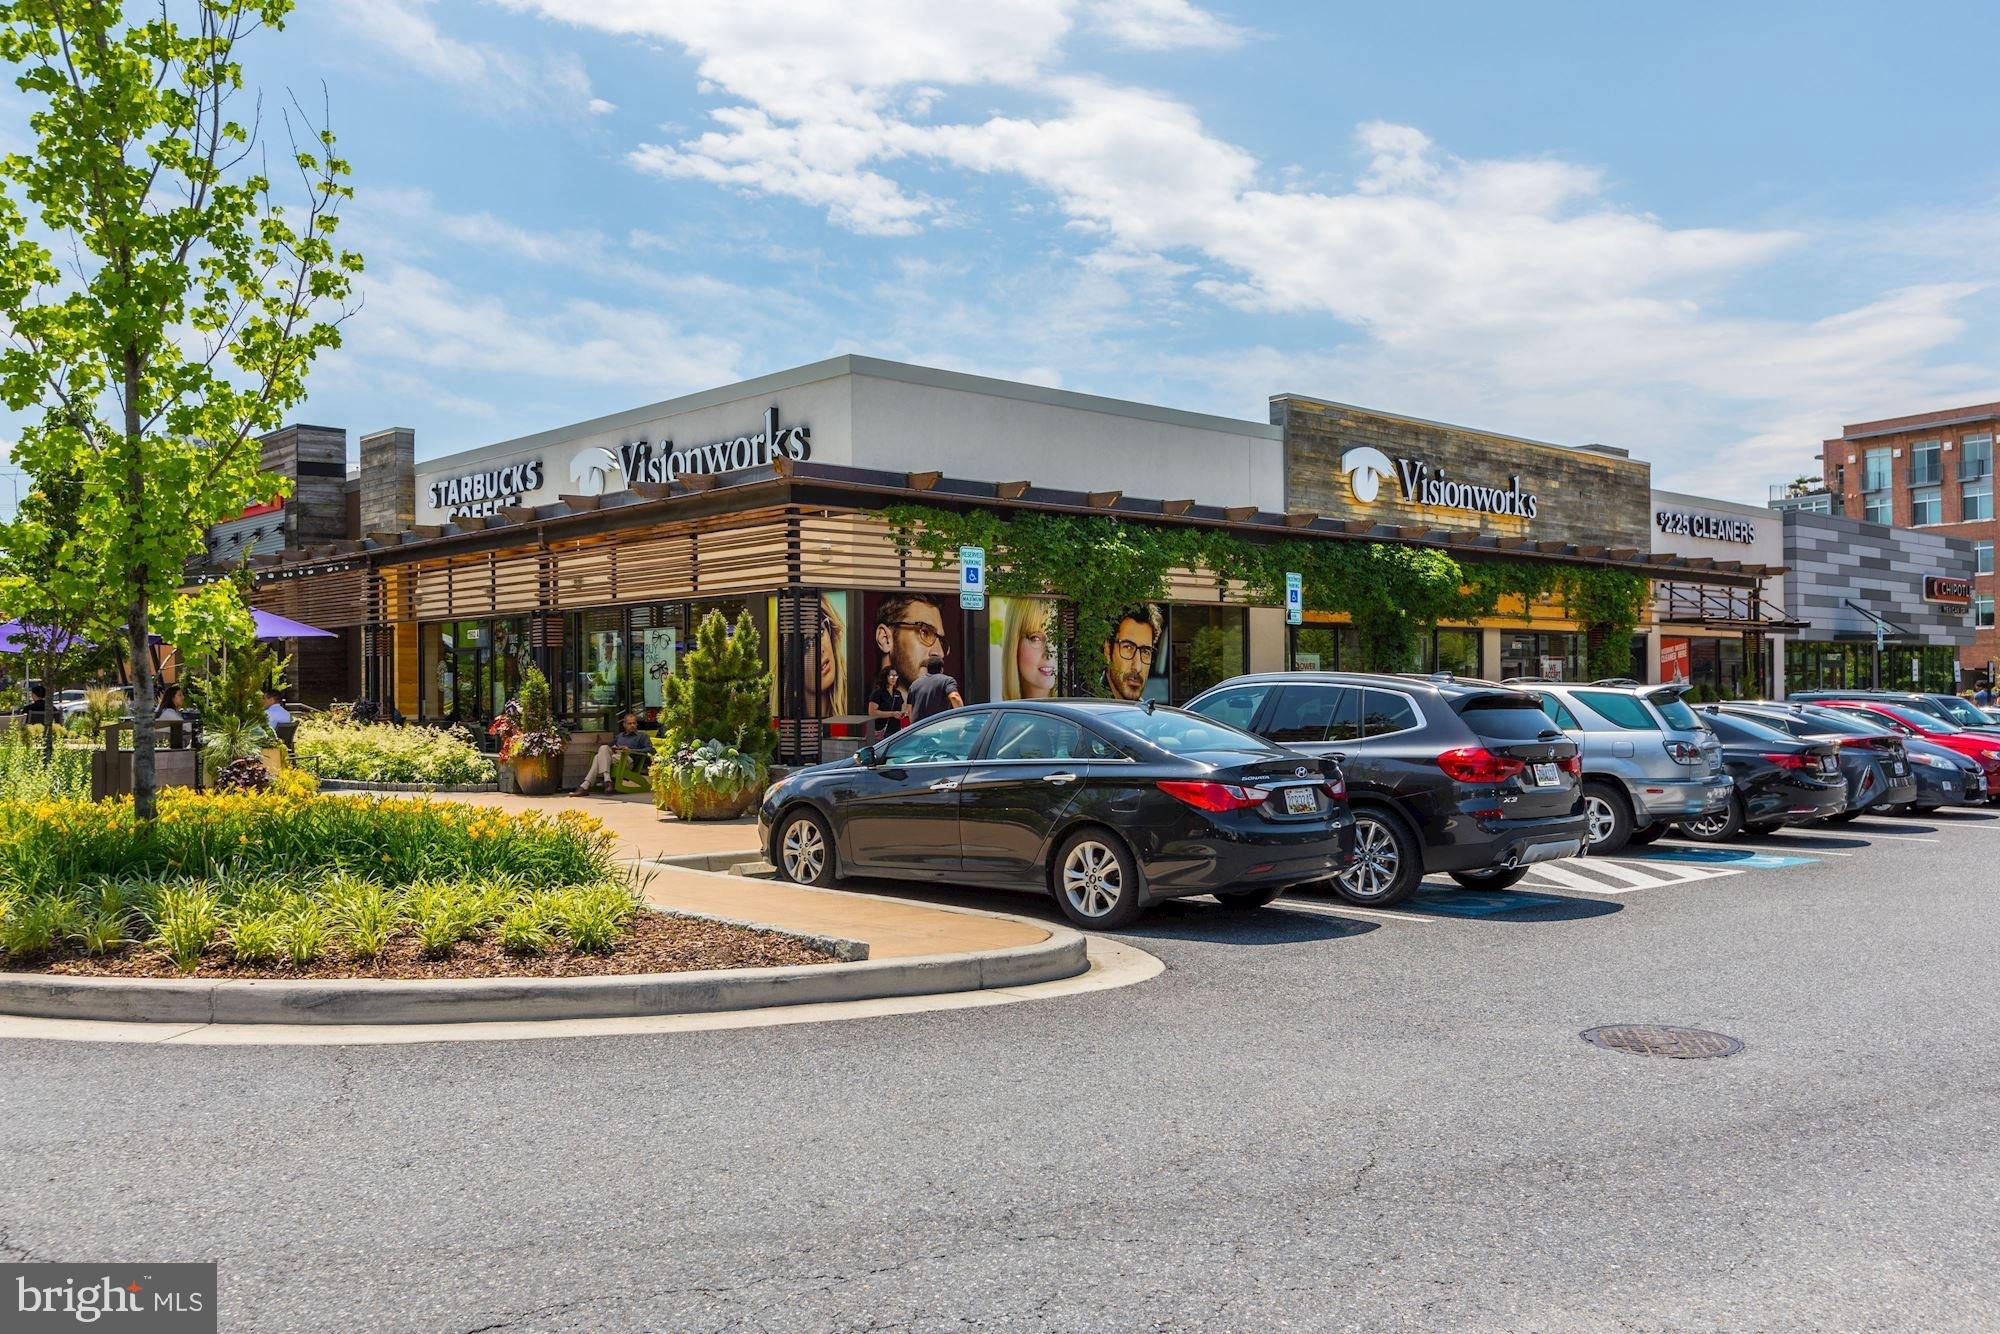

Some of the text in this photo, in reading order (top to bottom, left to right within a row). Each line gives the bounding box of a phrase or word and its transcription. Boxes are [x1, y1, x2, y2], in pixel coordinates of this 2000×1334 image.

[614, 407, 807, 489] Visionworks
[428, 460, 540, 508] STARBUCKS
[1398, 458, 1538, 519] Visionworks
[1660, 512, 1756, 544] $2.25 CLEANERS
[961, 551, 983, 559] RESERVED
[645, 643, 658, 654] BUY
[645, 654, 659, 664] ONE
